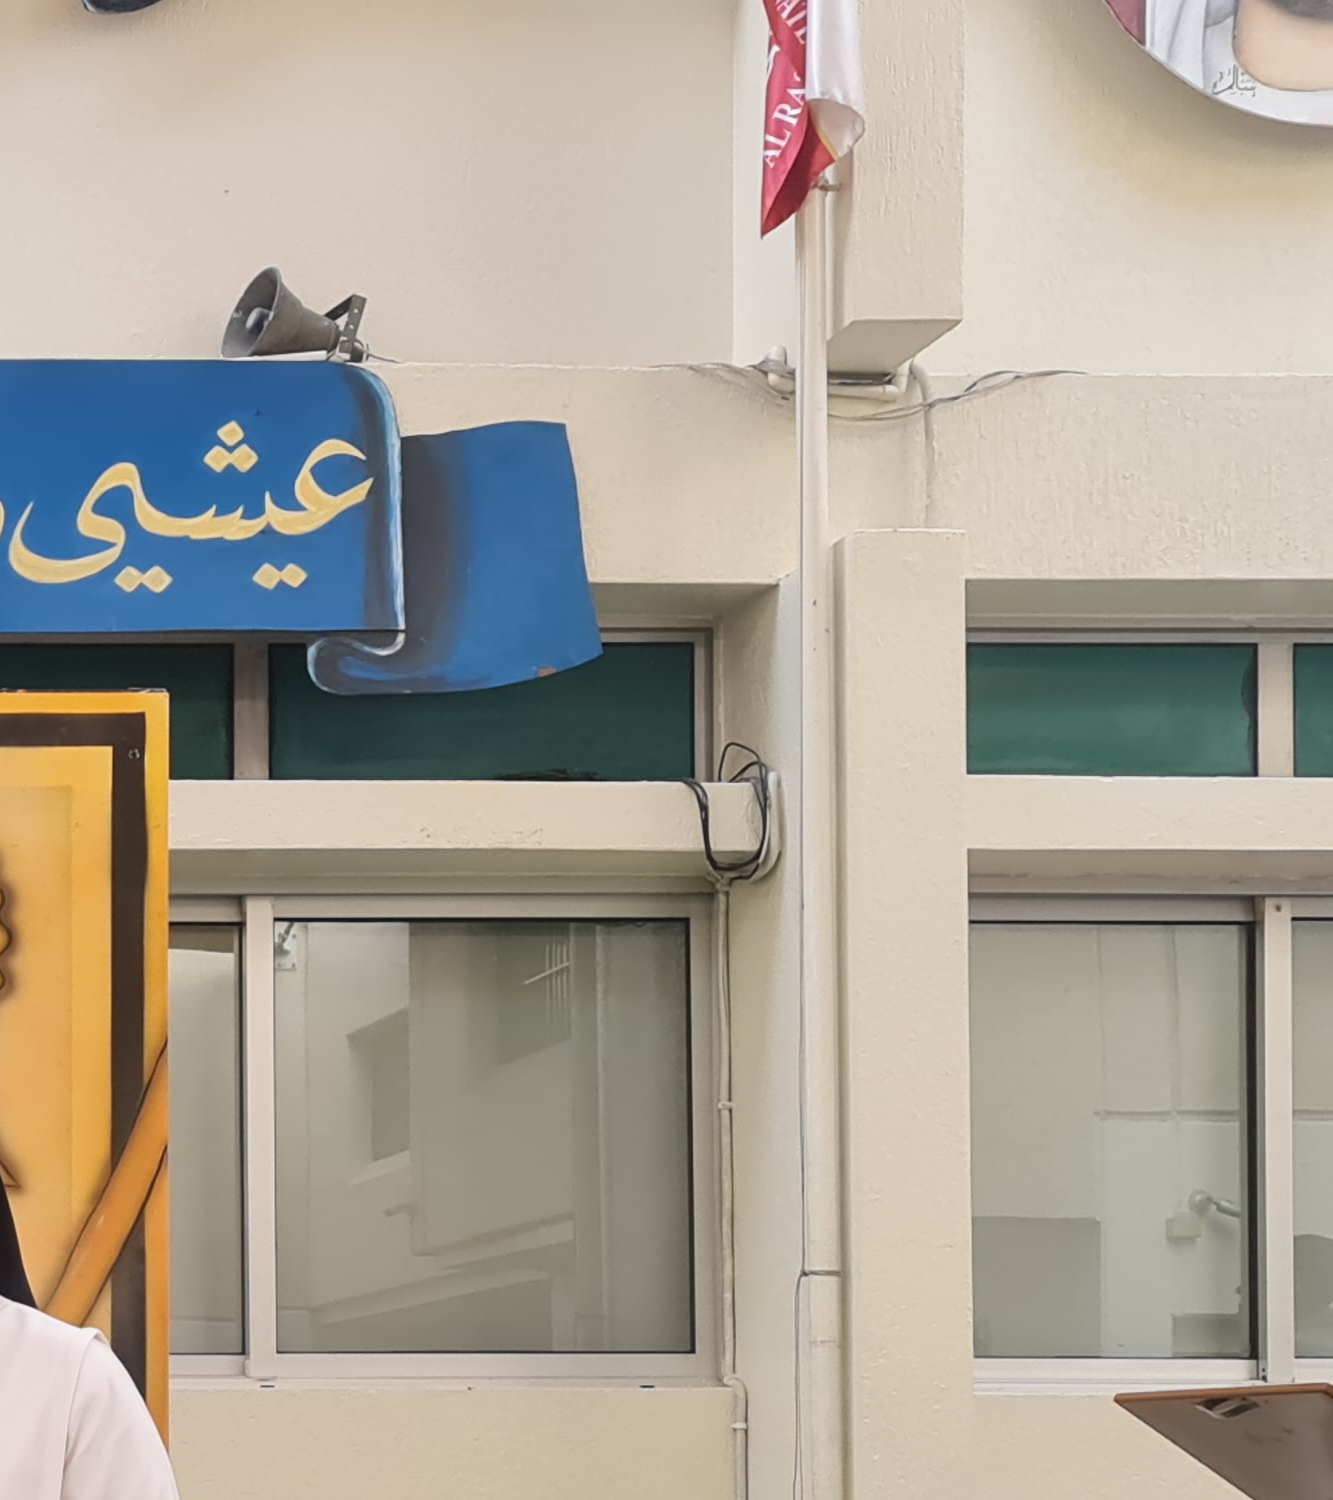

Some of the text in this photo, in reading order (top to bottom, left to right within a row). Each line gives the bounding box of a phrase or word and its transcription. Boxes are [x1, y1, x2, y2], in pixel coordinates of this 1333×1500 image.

[772, 72, 806, 127] RA
[763, 129, 791, 168] AL
[9, 421, 373, 593] عيشي
